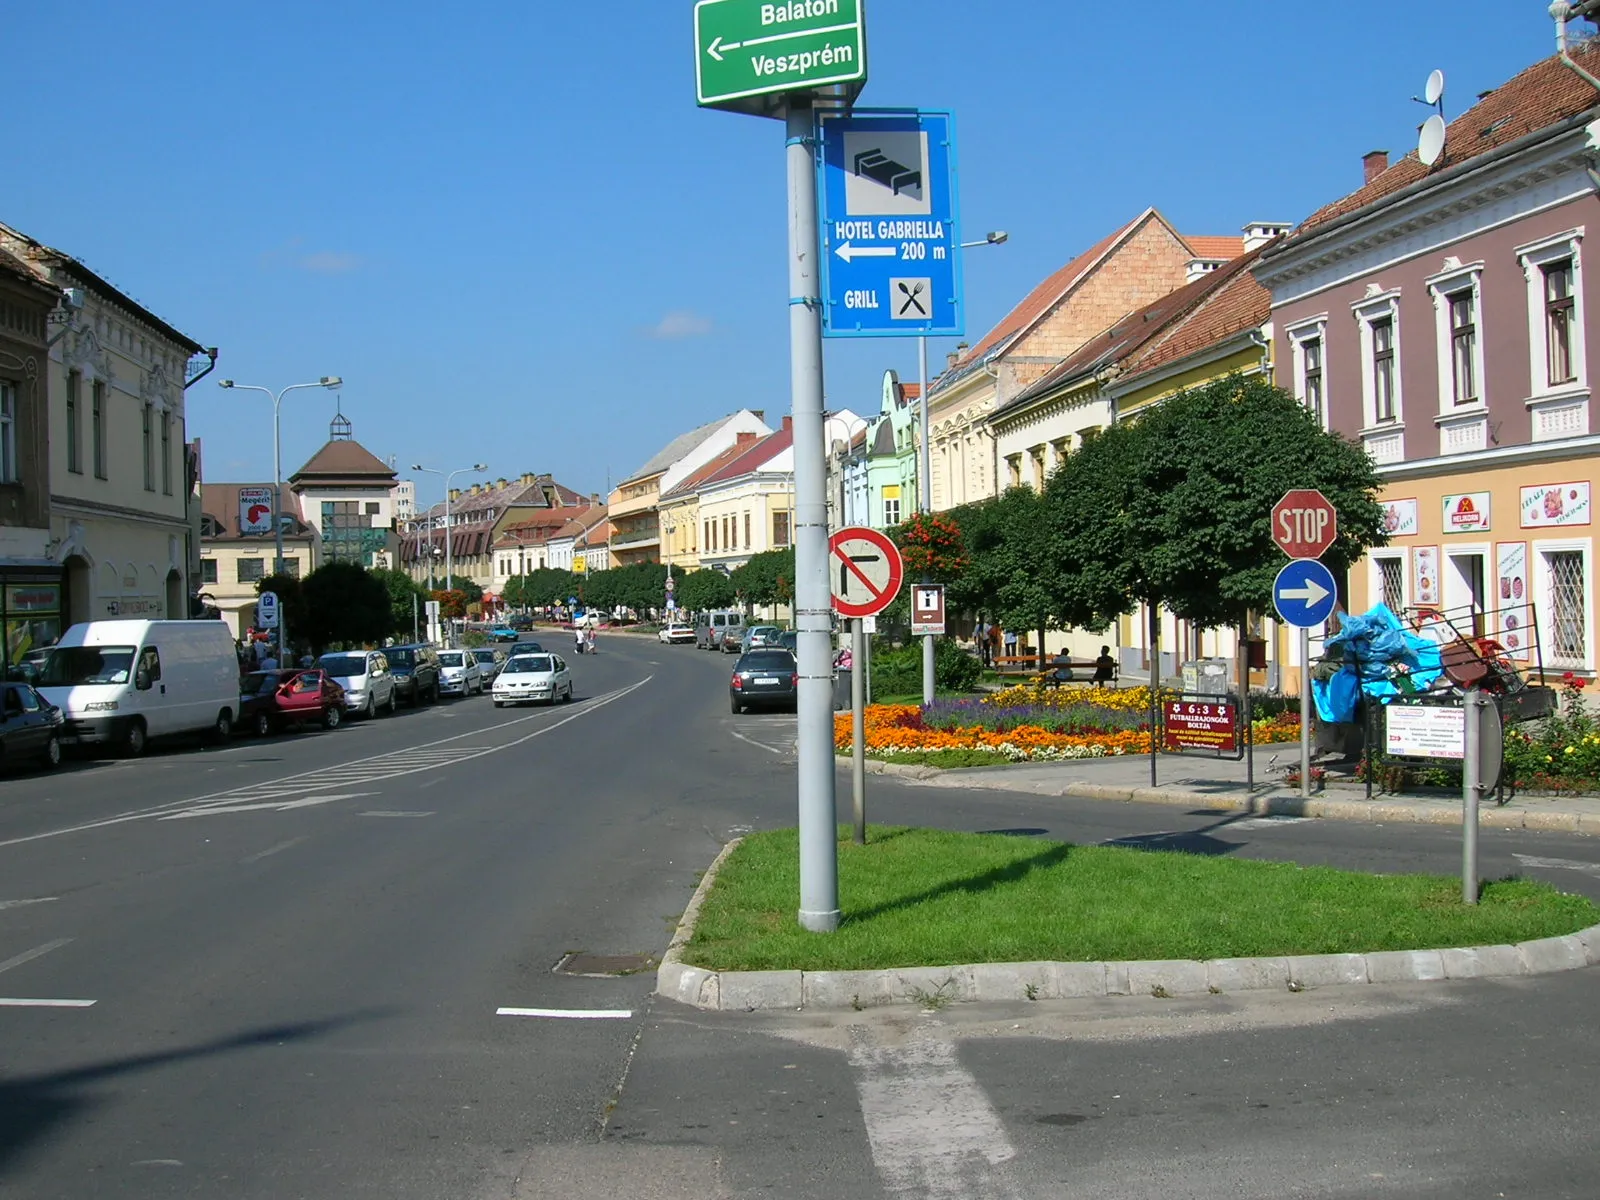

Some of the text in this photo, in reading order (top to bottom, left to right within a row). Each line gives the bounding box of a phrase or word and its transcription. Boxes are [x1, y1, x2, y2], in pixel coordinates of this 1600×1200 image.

[761, 0, 838, 25] Balaton
[751, 43, 853, 77] Veszprém
[835, 221, 944, 239] HOTEL GABRIELLA
[901, 242, 946, 260] 200 m
[844, 290, 879, 309] GRILL
[1279, 508, 1329, 544] STOP
